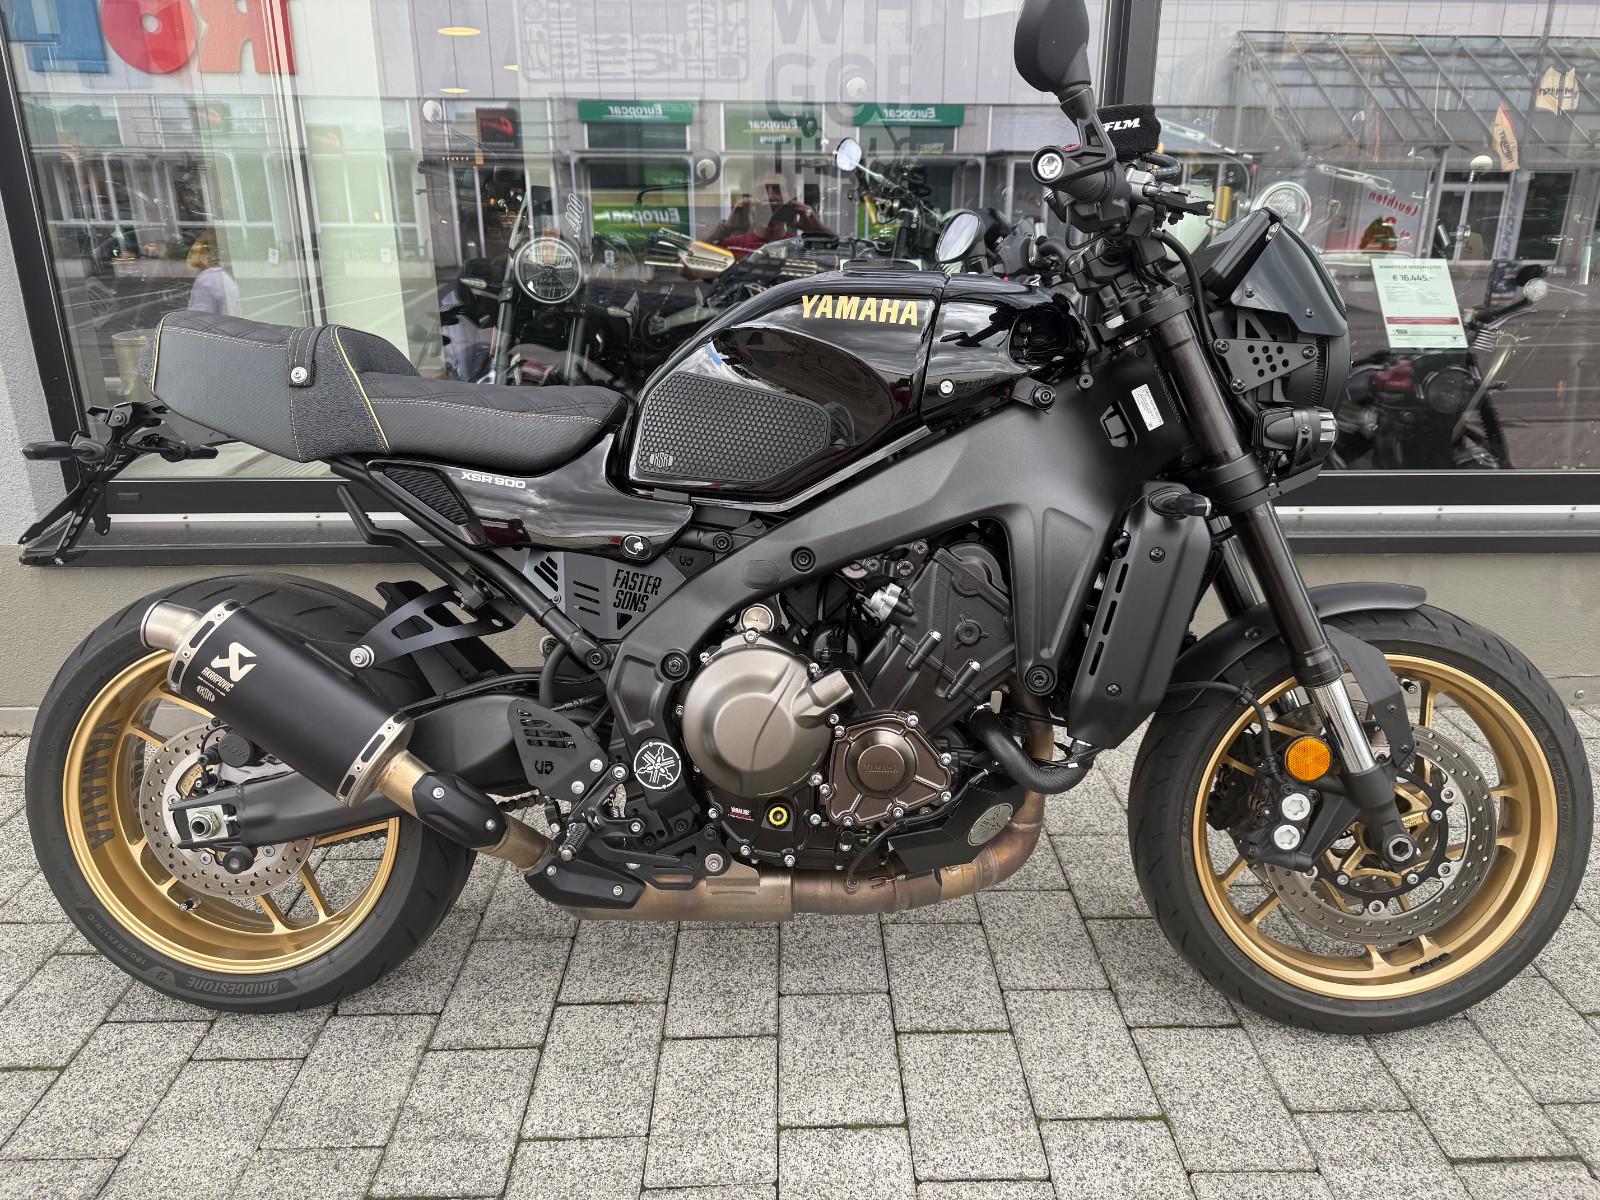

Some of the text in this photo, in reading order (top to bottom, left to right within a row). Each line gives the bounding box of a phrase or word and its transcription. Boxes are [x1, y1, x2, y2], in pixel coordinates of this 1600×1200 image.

[1103, 117, 1140, 132] FLM
[801, 294, 918, 326] YAMAHA
[461, 471, 526, 489] XSR 900
[612, 568, 663, 596] FASTER
[612, 589, 650, 613] SONS
[81, 718, 124, 850] YAMAHA
